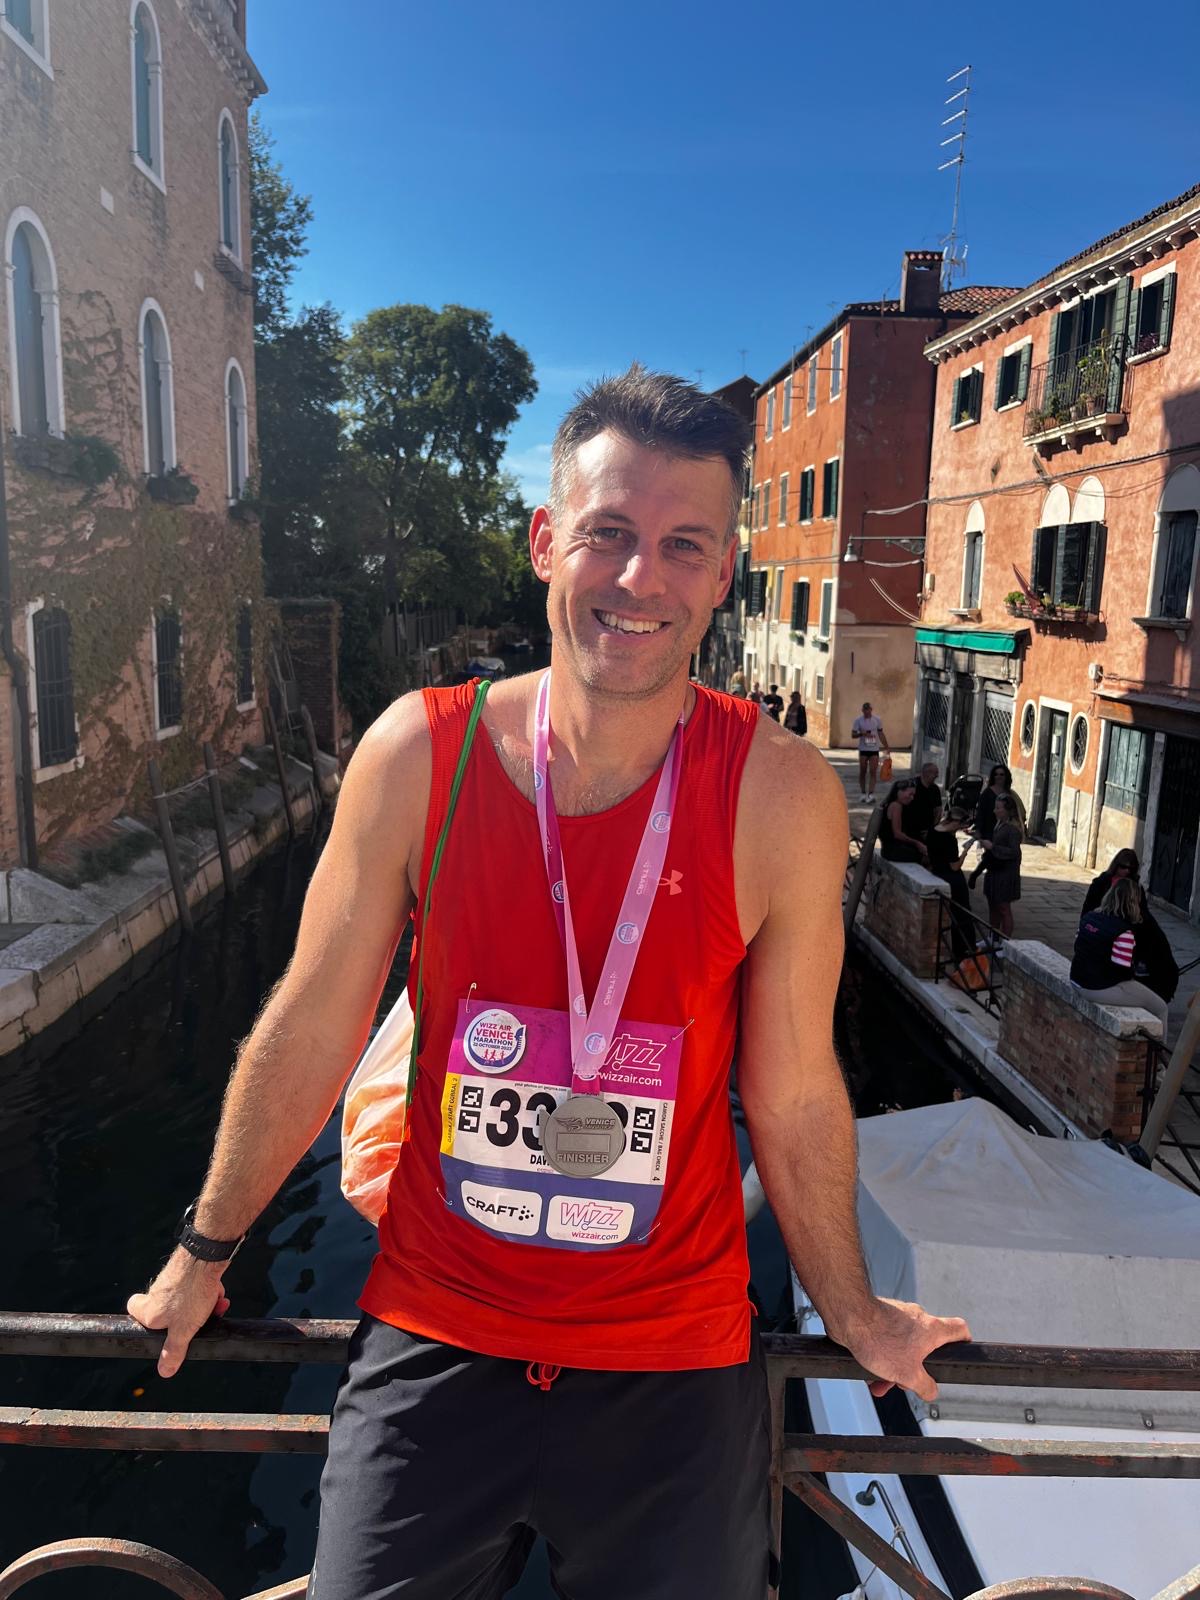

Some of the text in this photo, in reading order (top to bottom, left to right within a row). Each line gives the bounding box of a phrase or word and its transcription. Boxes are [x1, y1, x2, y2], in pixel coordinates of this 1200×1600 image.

[476, 1028, 514, 1040] VENICE
[473, 1036, 513, 1046] MARATHON
[600, 1071, 662, 1086] wizzair.com
[486, 1088, 628, 1156] 33
[585, 1118, 616, 1126] VENICE
[557, 1153, 609, 1163] FINISHER
[466, 1196, 519, 1217] CRAFT
[571, 1230, 619, 1241] wizzair.com
